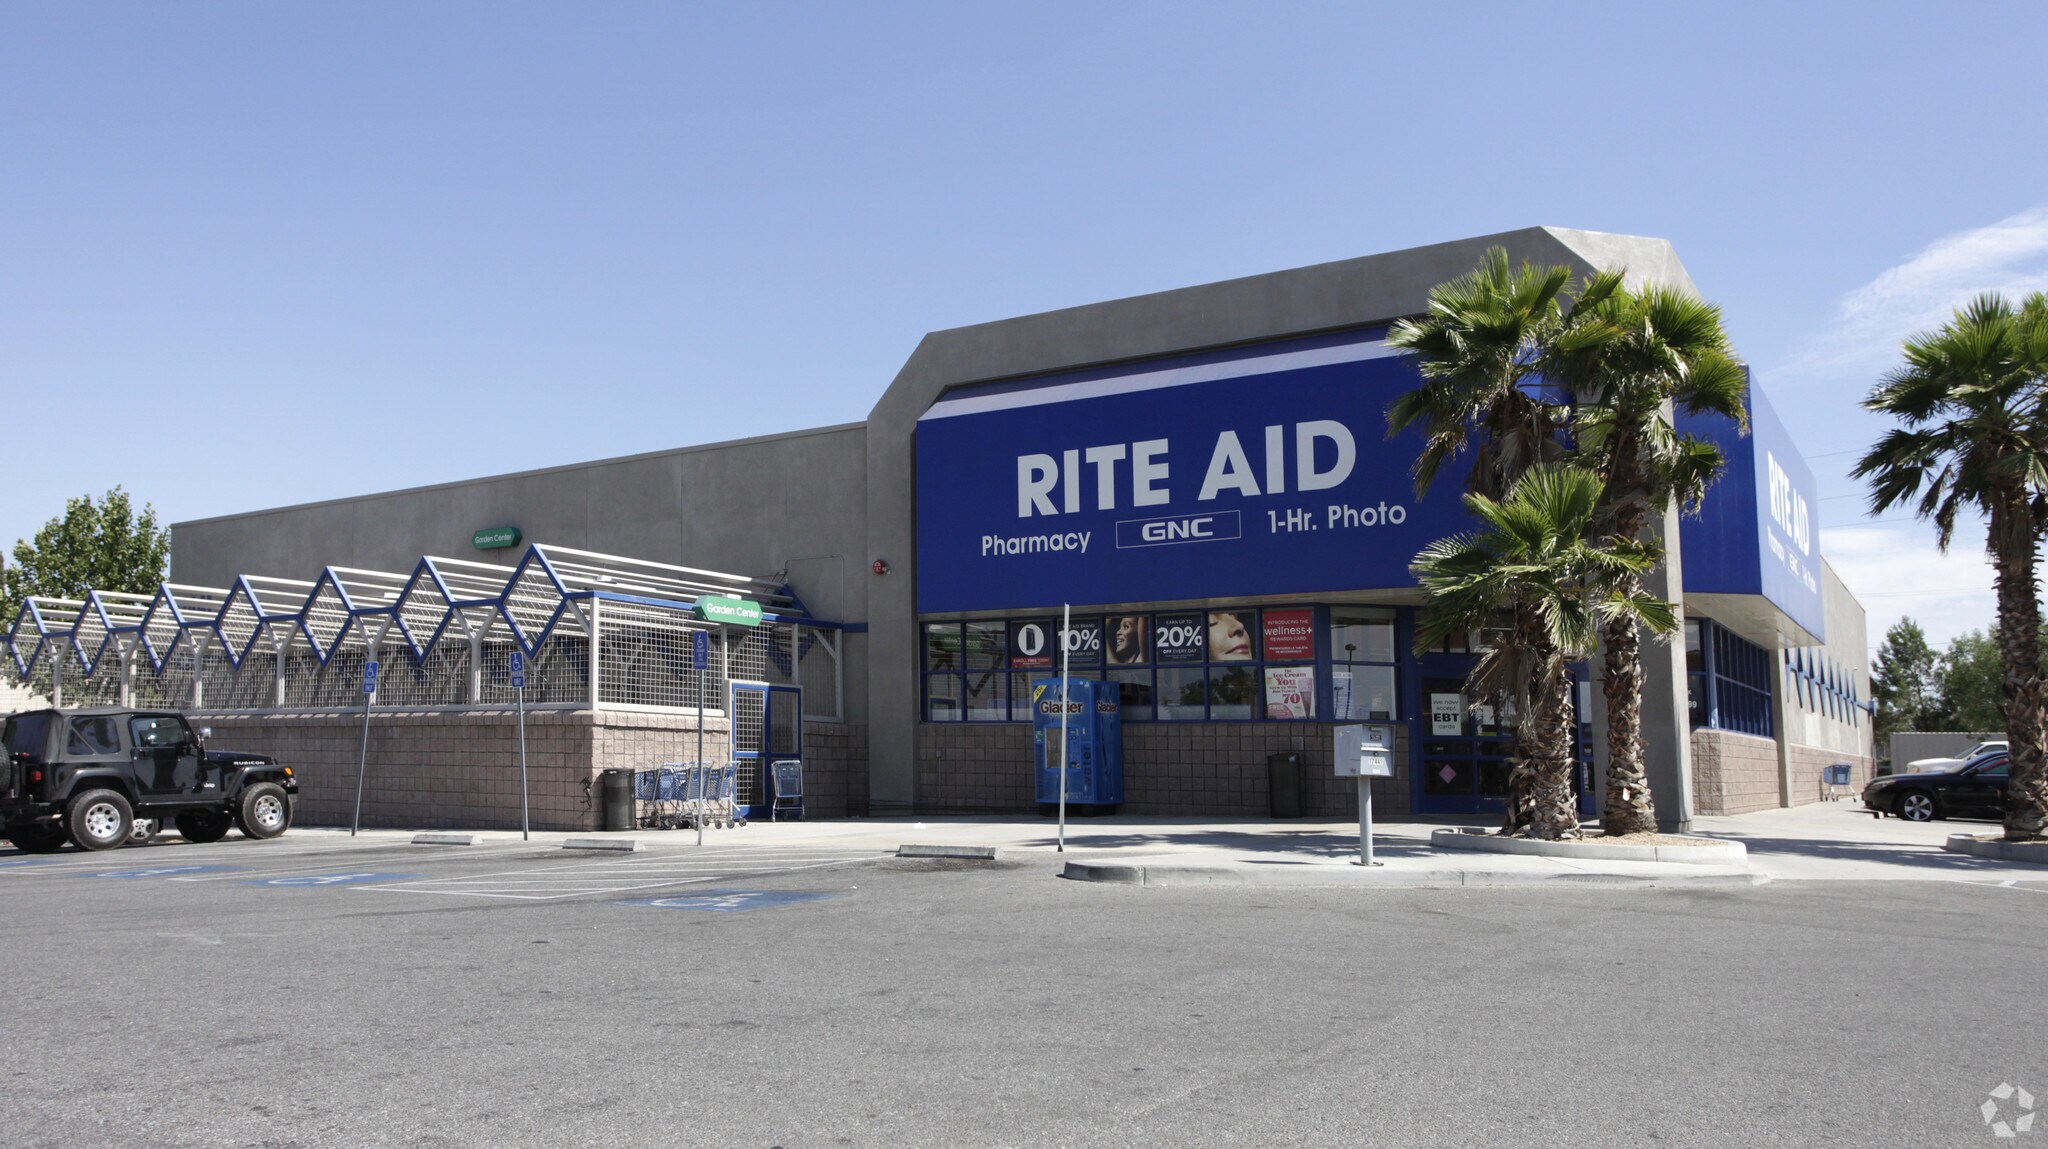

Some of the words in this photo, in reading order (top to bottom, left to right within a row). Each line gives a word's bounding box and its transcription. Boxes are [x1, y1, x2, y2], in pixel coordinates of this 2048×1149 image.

[1017, 438, 1170, 518] RITE
[1197, 419, 1356, 501] AID
[1767, 449, 1793, 538] RITE
[1793, 487, 1809, 557] AID
[1267, 508, 1317, 534] 1-Hr.
[1327, 501, 1407, 529] Photo
[1142, 517, 1213, 541] GNC
[982, 531, 1091, 557] Pharmacy
[706, 603, 735, 615] Garden
[736, 606, 760, 618] Center
[1058, 629, 1100, 651] 10%
[1157, 625, 1202, 647] 20%
[1276, 677, 1296, 686] You
[1040, 701, 1083, 713] Glacier
[1096, 701, 1117, 712] Glacier
[1282, 693, 1301, 704] 70
[1434, 713, 1459, 722] EBT
